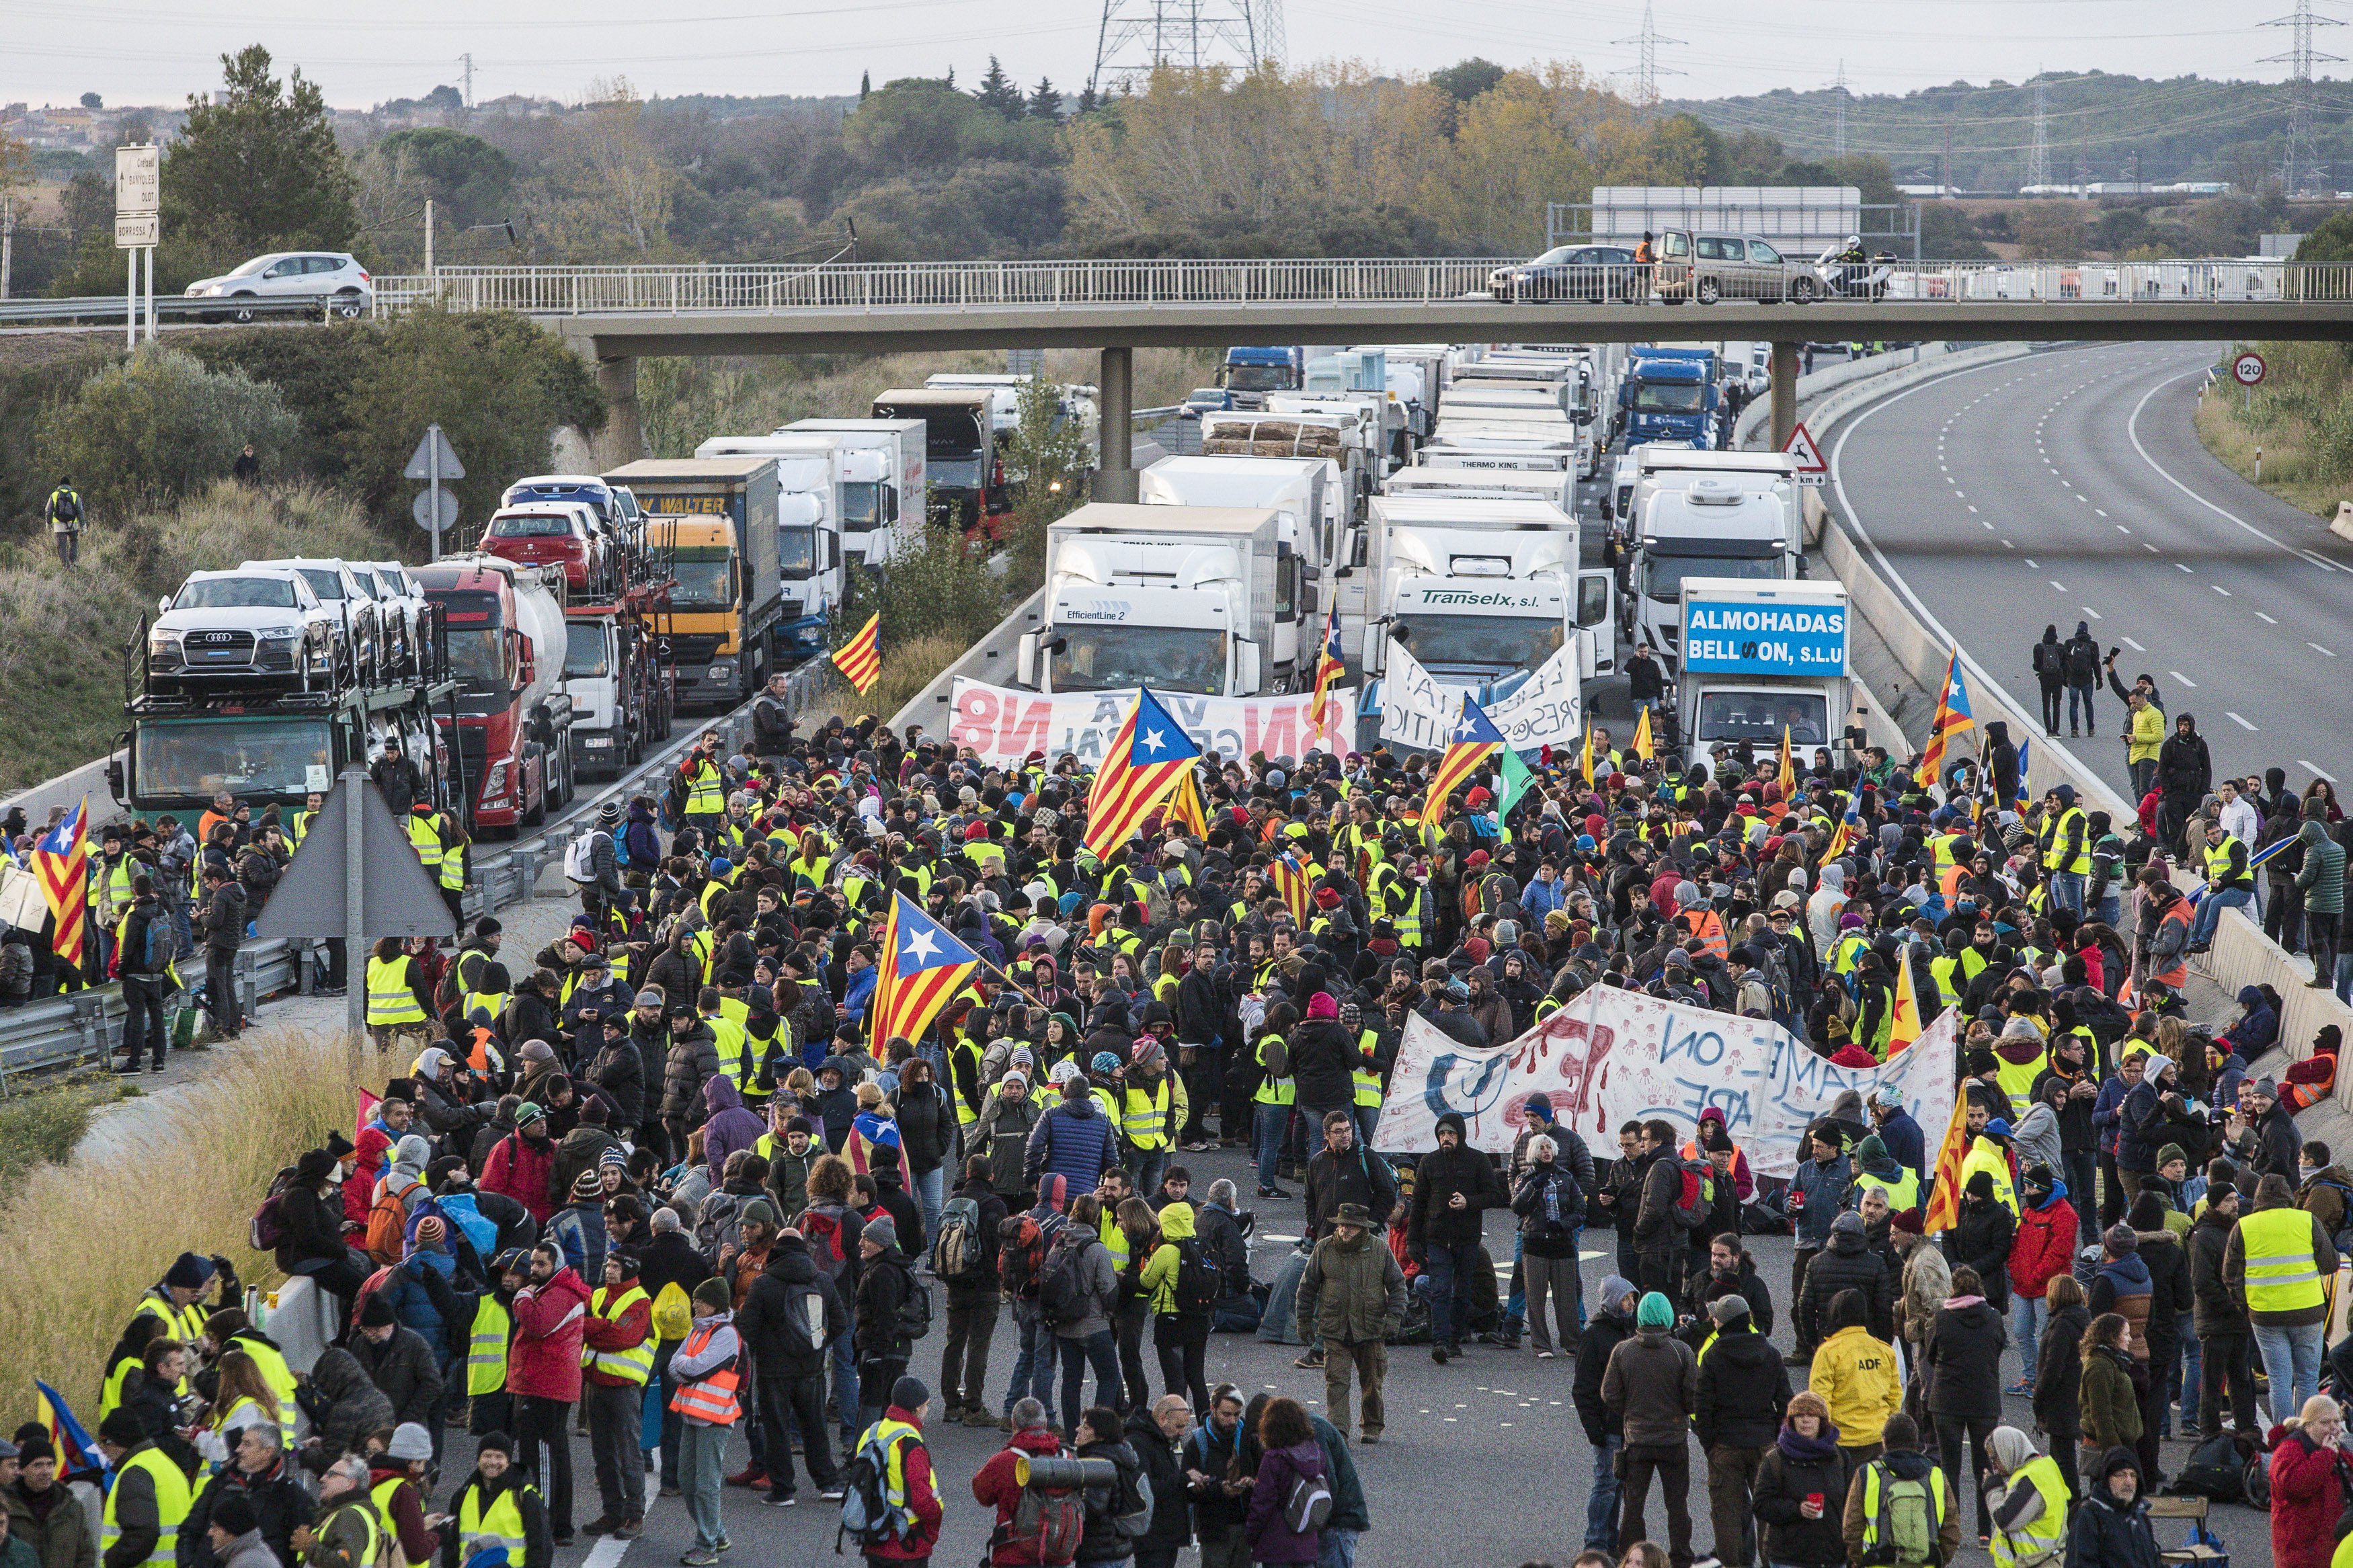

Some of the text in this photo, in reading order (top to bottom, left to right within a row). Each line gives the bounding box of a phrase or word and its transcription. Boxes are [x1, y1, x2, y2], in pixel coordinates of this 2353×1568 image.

[129, 174, 155, 185] BANYOLES
[141, 192, 154, 202] OLOT
[2239, 364, 2261, 375] 120
[1800, 475, 1813, 484] km
[660, 497, 725, 514] WALTER
[1422, 589, 1540, 608] Transelx, s.l.
[1067, 610, 1125, 621] EfficientLine 2
[1689, 610, 1844, 634] ALMOHADAS
[1800, 647, 1843, 663] S.L.U
[1858, 1358, 1882, 1371] ADF
